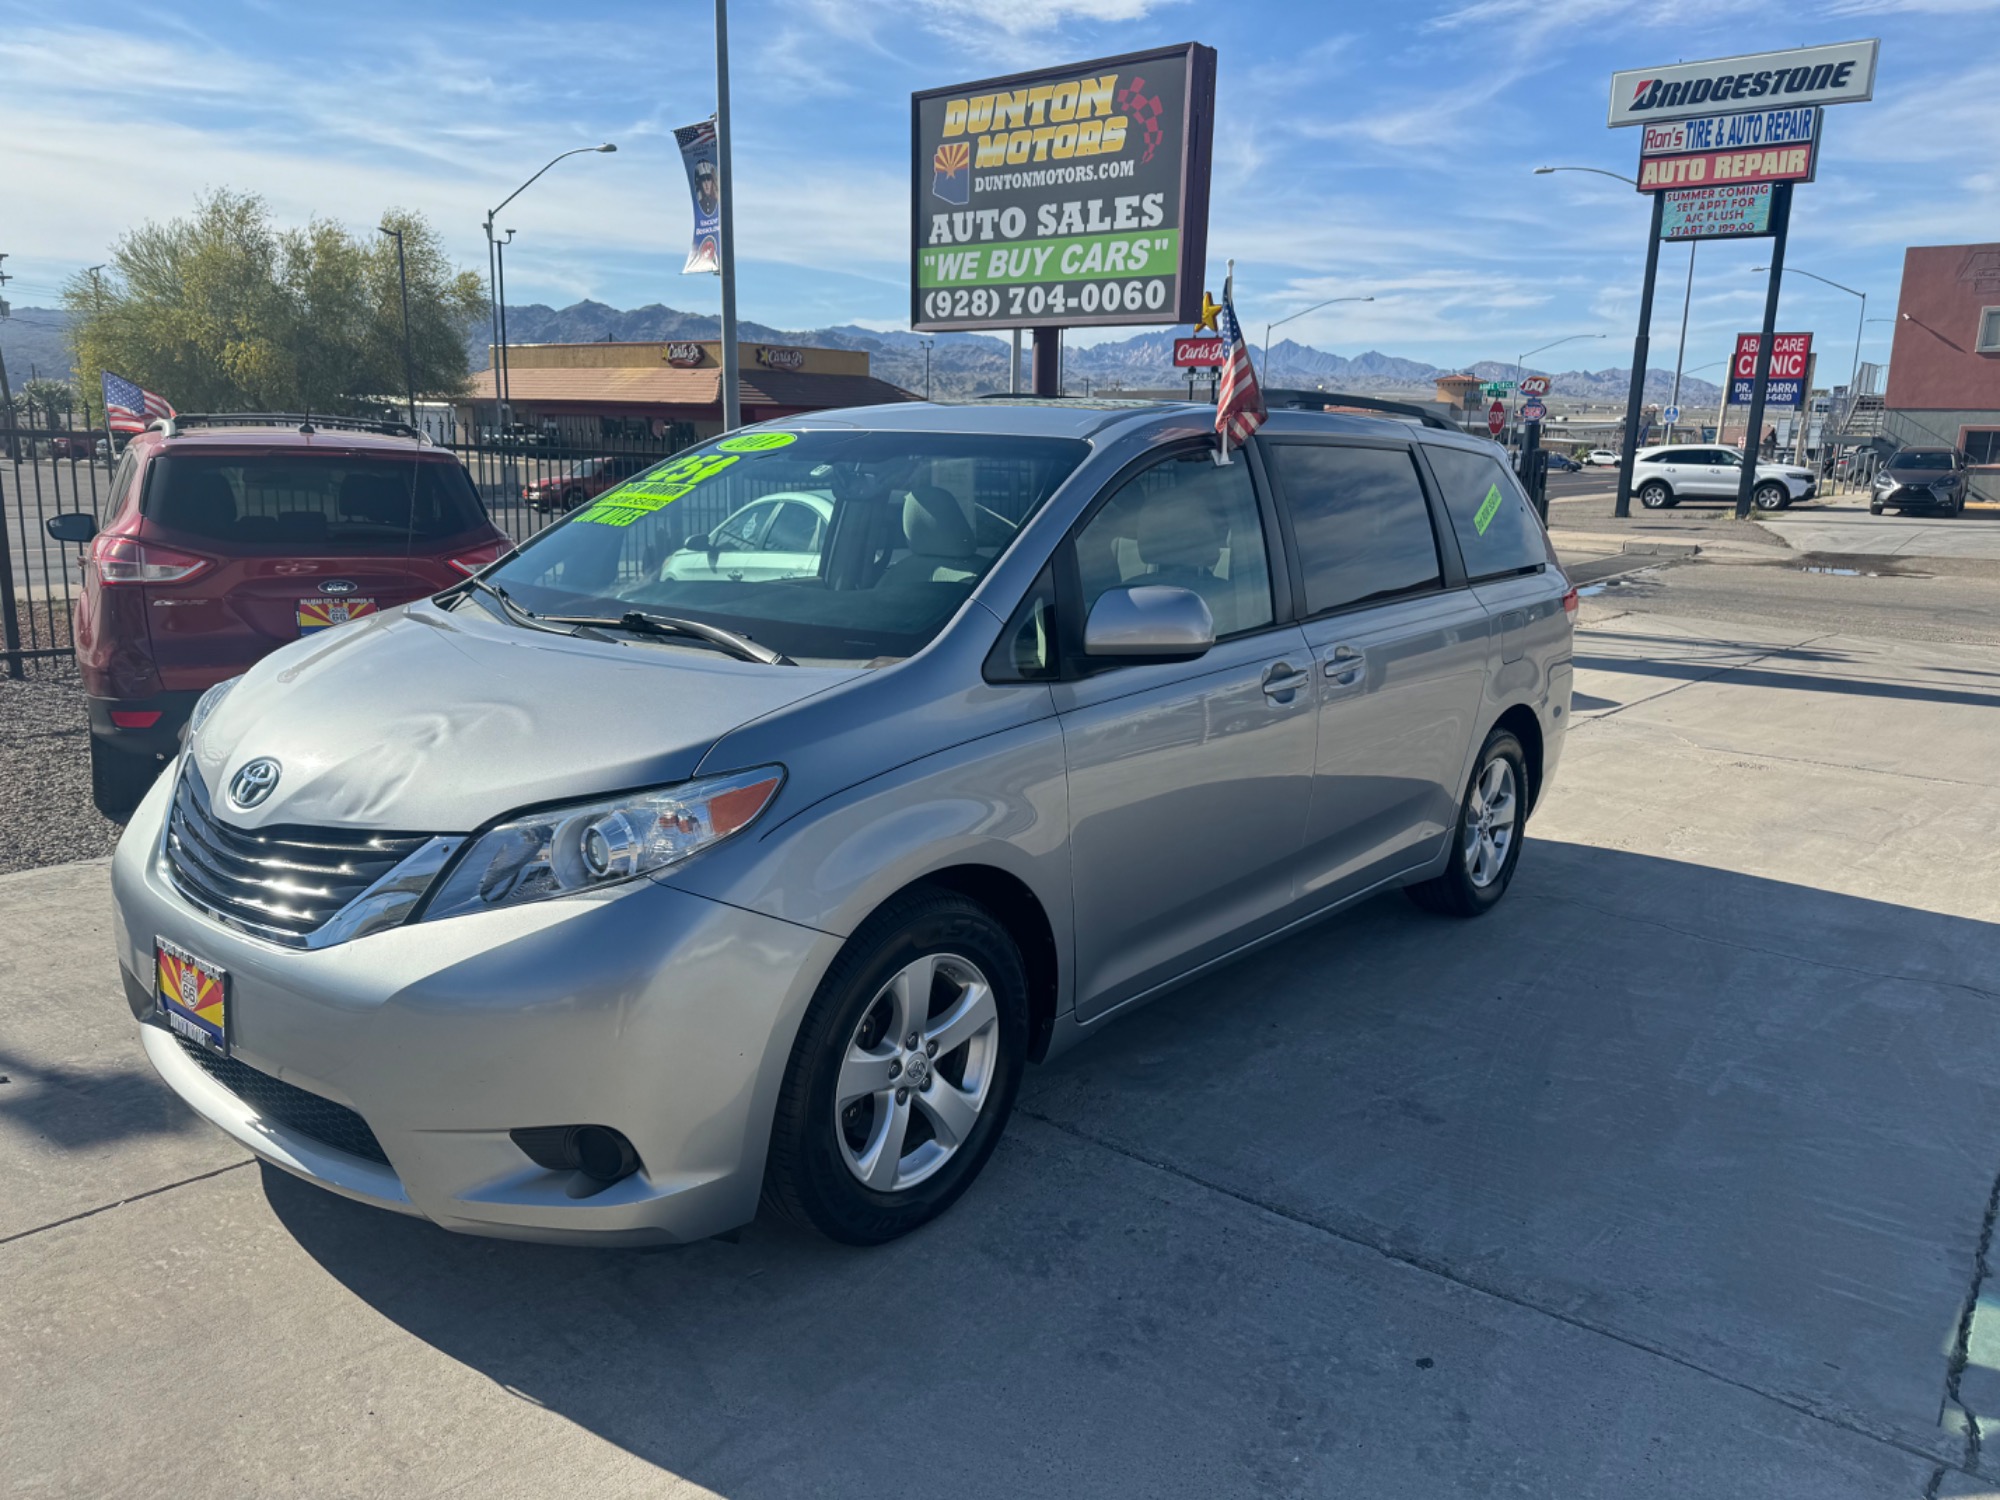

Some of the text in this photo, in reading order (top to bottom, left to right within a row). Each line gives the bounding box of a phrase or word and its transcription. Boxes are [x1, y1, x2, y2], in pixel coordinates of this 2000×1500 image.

[1629, 61, 1855, 111] BRIDGESTONE
[942, 74, 1118, 137] DUNTON
[1644, 109, 1812, 149] Ron's TIRE & AUTO REPAIR
[975, 116, 1128, 168] MOTORS
[975, 160, 1135, 193] DUNTONMOTORS.COM
[1641, 150, 1806, 185] AUTO REPAIR
[1667, 184, 1769, 202] SUMMER COMING
[1676, 197, 1755, 213] SET APPT FOR
[929, 193, 1164, 244] AUTO SALES
[1685, 210, 1744, 223] A/C FLUSH
[1670, 225, 1704, 236] START
[924, 238, 1169, 281] "WE BUY CARS"
[925, 279, 1166, 318] (928) 704-0060
[1177, 342, 1209, 361] Carl's
[1773, 338, 1805, 352] CARE
[1738, 355, 1802, 375] CLNIC
[1525, 380, 1546, 392] DQ
[1735, 382, 1752, 393] DR.
[1489, 412, 1504, 425] STOP
[327, 582, 348, 591] Ford
[331, 613, 347, 621] 66
[183, 984, 196, 1003] 66
